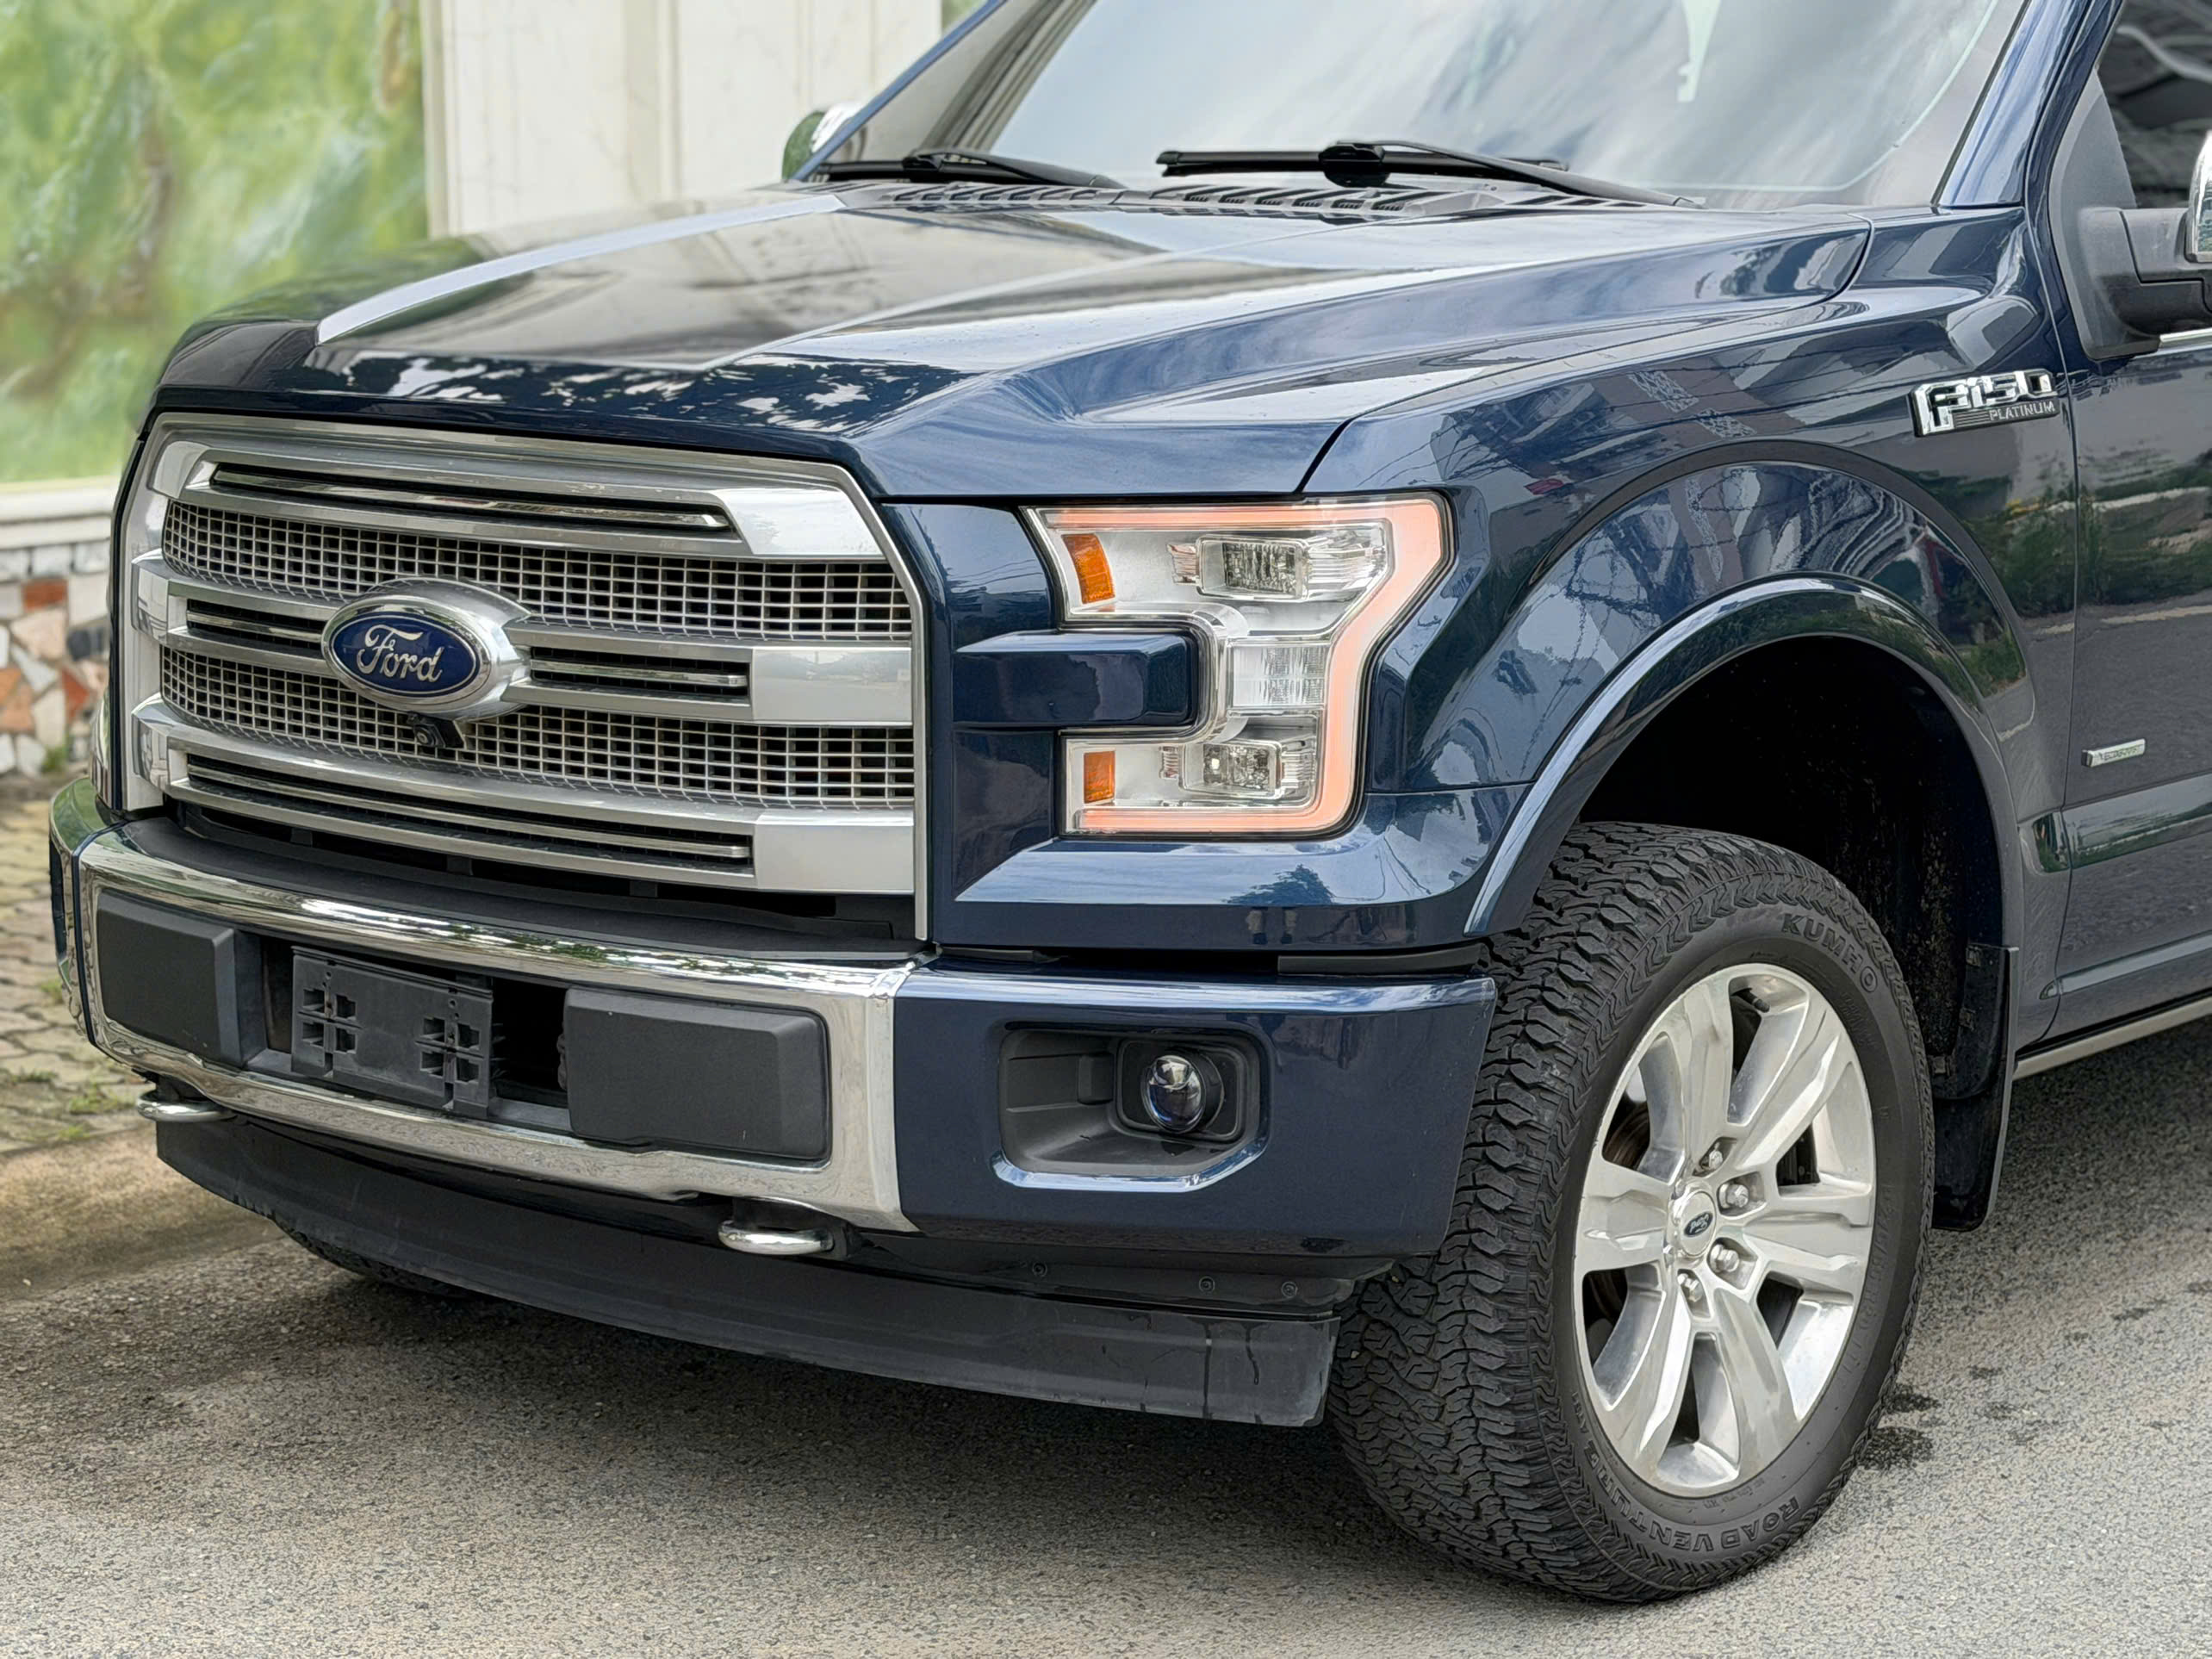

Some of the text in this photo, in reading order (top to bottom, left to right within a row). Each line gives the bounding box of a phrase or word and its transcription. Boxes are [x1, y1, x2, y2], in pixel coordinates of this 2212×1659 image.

[1987, 400, 2056, 422] PLATINUM
[356, 624, 444, 682] Ford
[1780, 912, 1878, 993] KUMHO
[1583, 1439, 1715, 1552] VENTURE
[1720, 1495, 1800, 1549] ROAD
